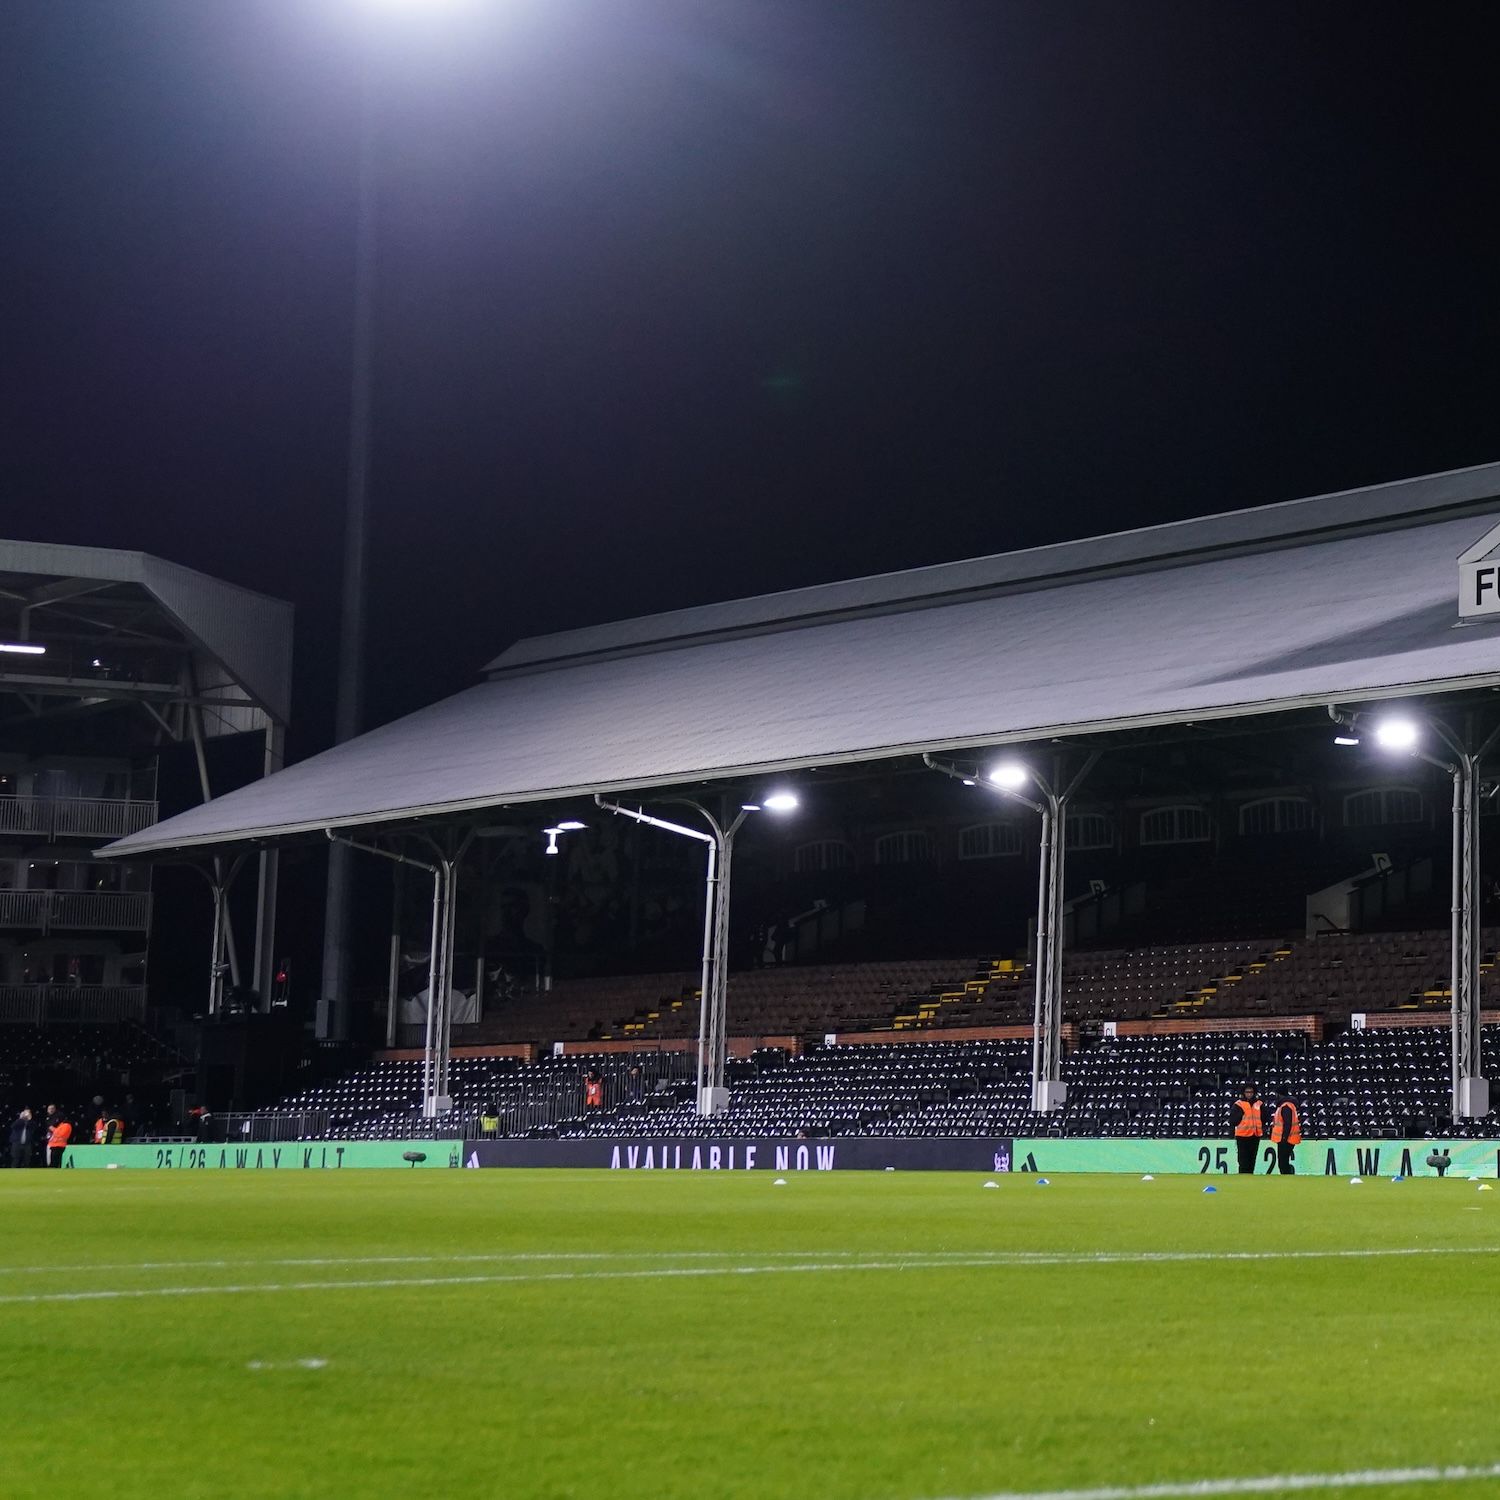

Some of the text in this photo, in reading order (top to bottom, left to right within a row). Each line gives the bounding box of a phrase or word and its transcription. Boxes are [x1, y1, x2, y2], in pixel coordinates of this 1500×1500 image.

[157, 1147, 345, 1168] 25/26 AWAY KIT
[611, 1145, 835, 1170] AVAILABLE NOW
[1325, 1148, 1449, 1177] AWAY
